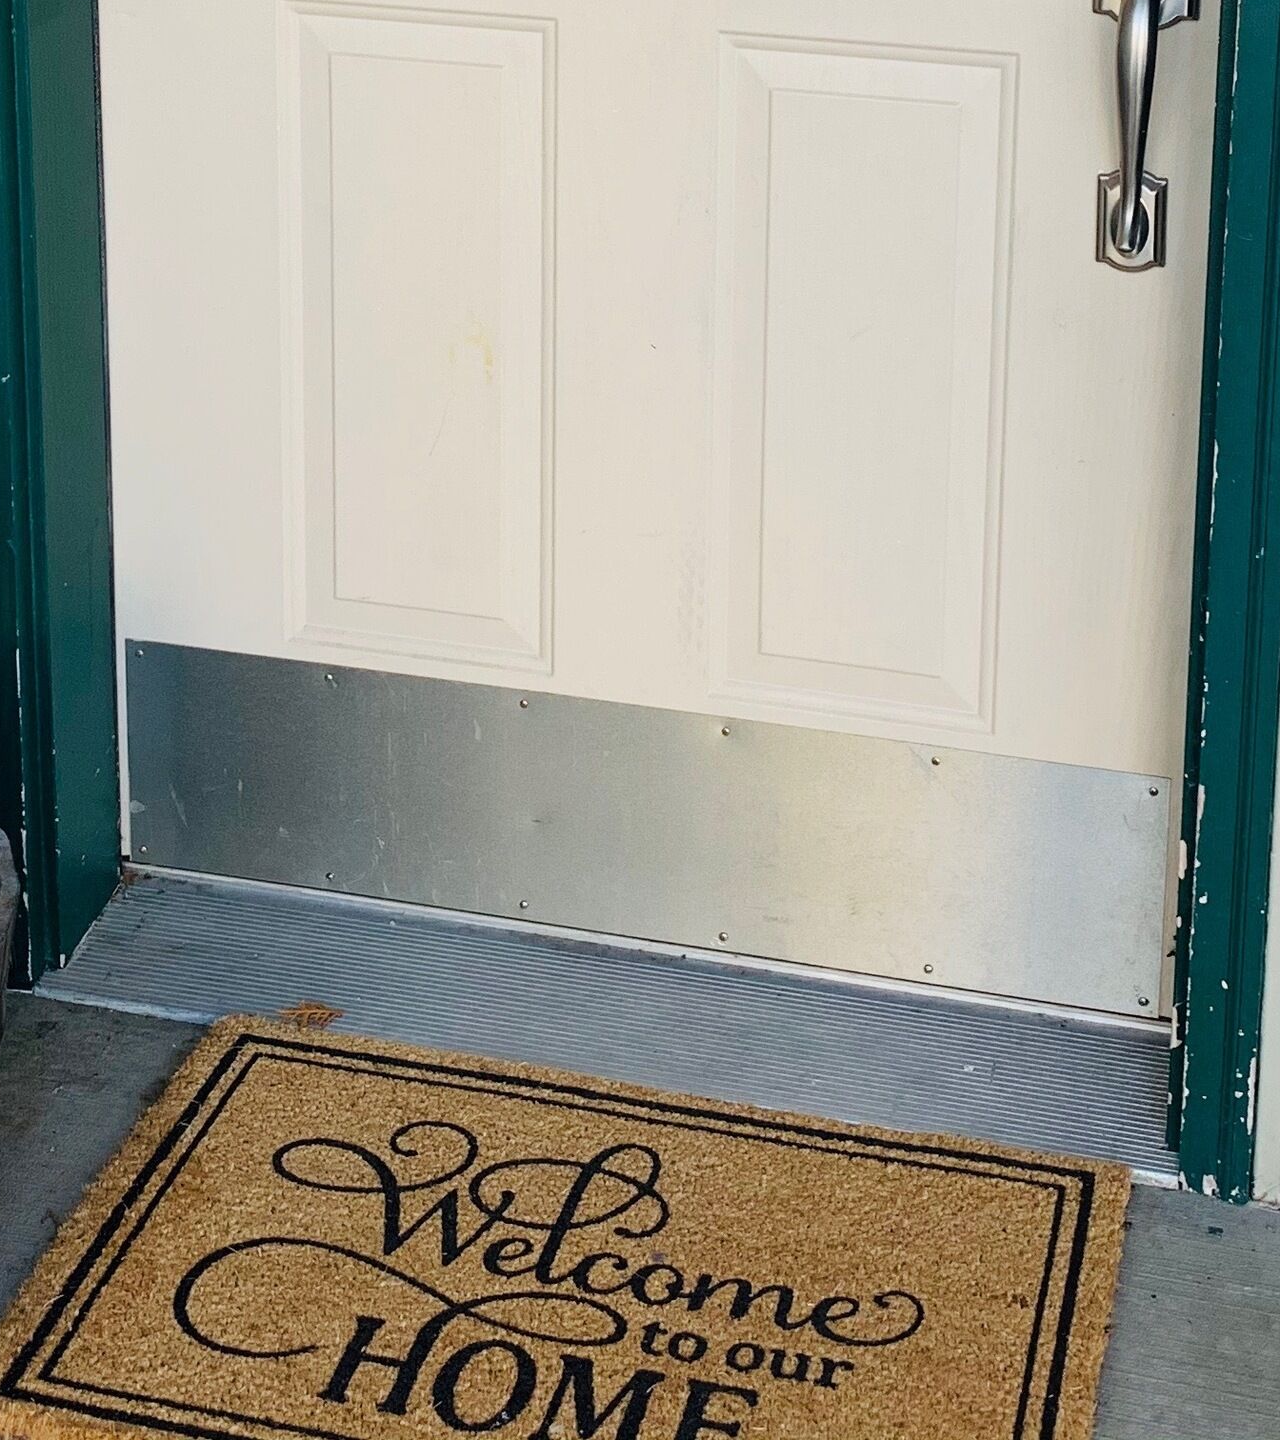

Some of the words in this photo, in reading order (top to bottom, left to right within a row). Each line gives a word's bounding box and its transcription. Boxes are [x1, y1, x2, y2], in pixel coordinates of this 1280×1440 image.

[272, 1120, 925, 1347] Welcome
[316, 1297, 760, 1440] HOME
[640, 1322, 710, 1364] to
[725, 1343, 855, 1390] our
